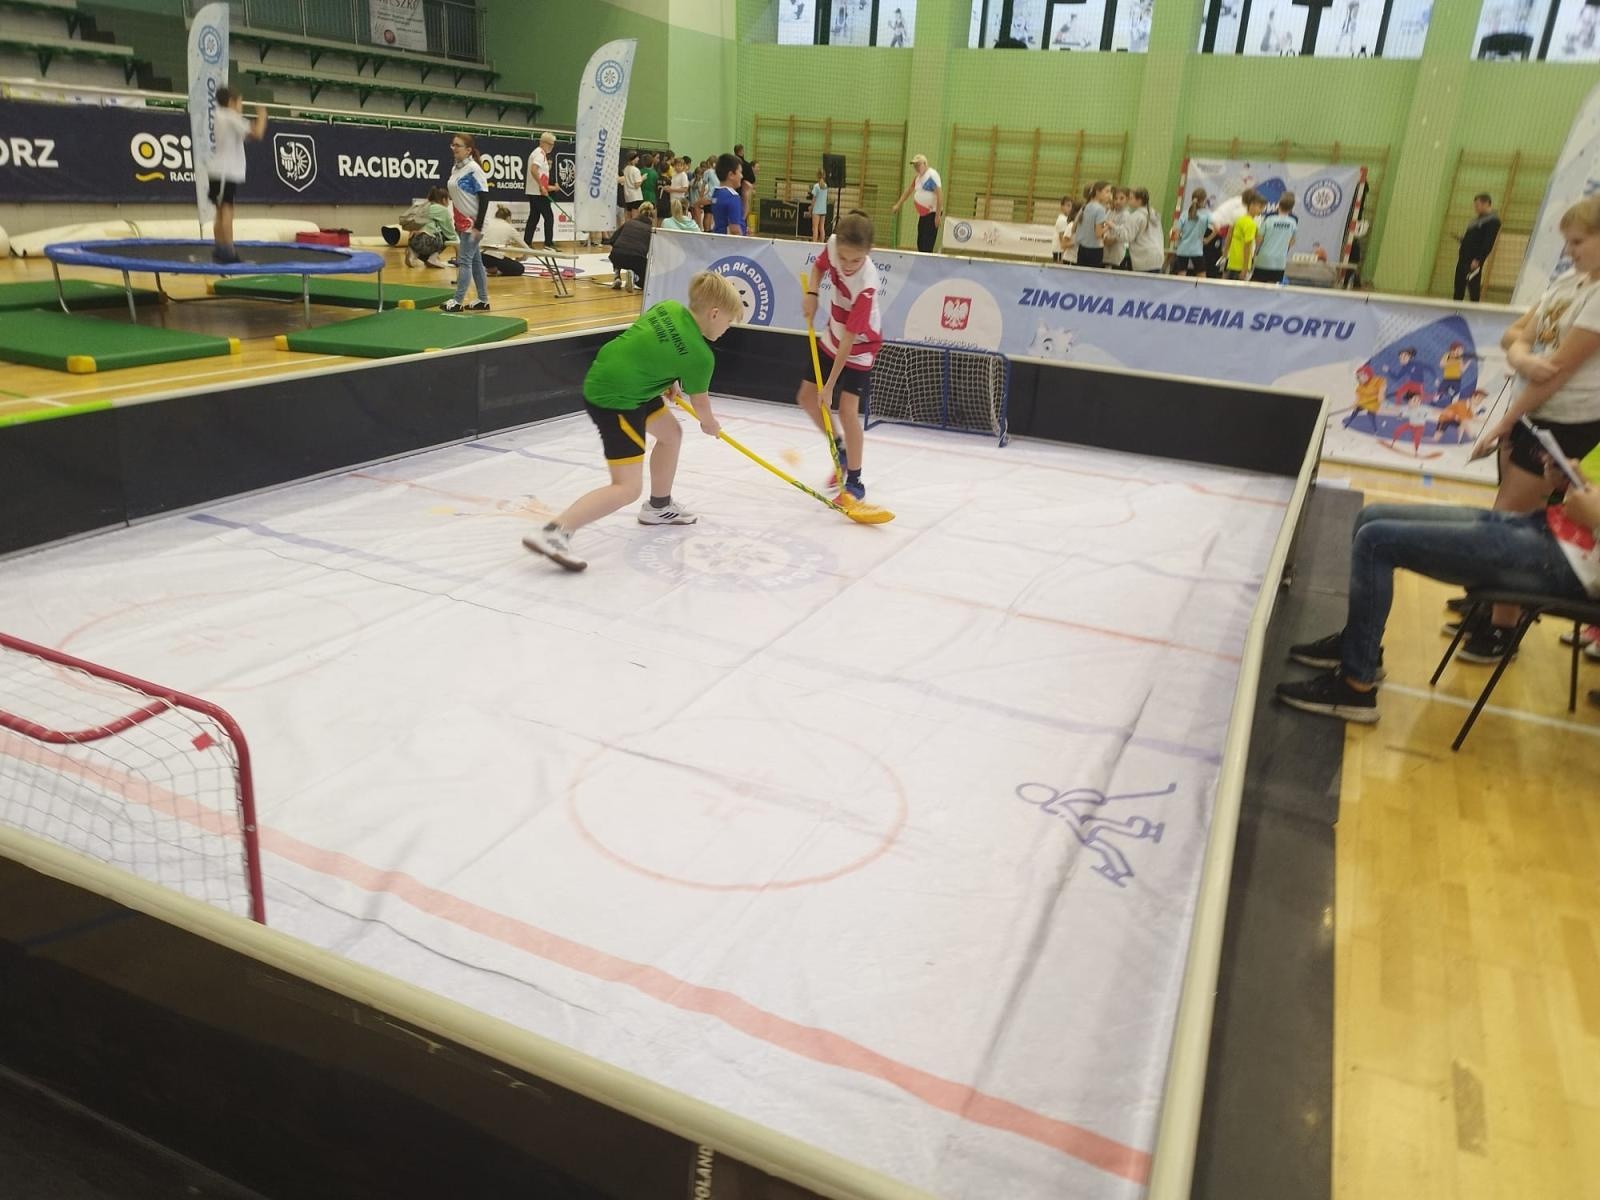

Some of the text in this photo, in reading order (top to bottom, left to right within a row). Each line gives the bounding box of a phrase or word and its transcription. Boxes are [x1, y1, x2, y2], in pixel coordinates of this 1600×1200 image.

[169, 171, 197, 182] RACI
[338, 151, 440, 180] RACIBÓRZ
[589, 127, 608, 199] CURLING
[1018, 287, 1356, 341] ZIMOWA AKADEMIA SPORTU
